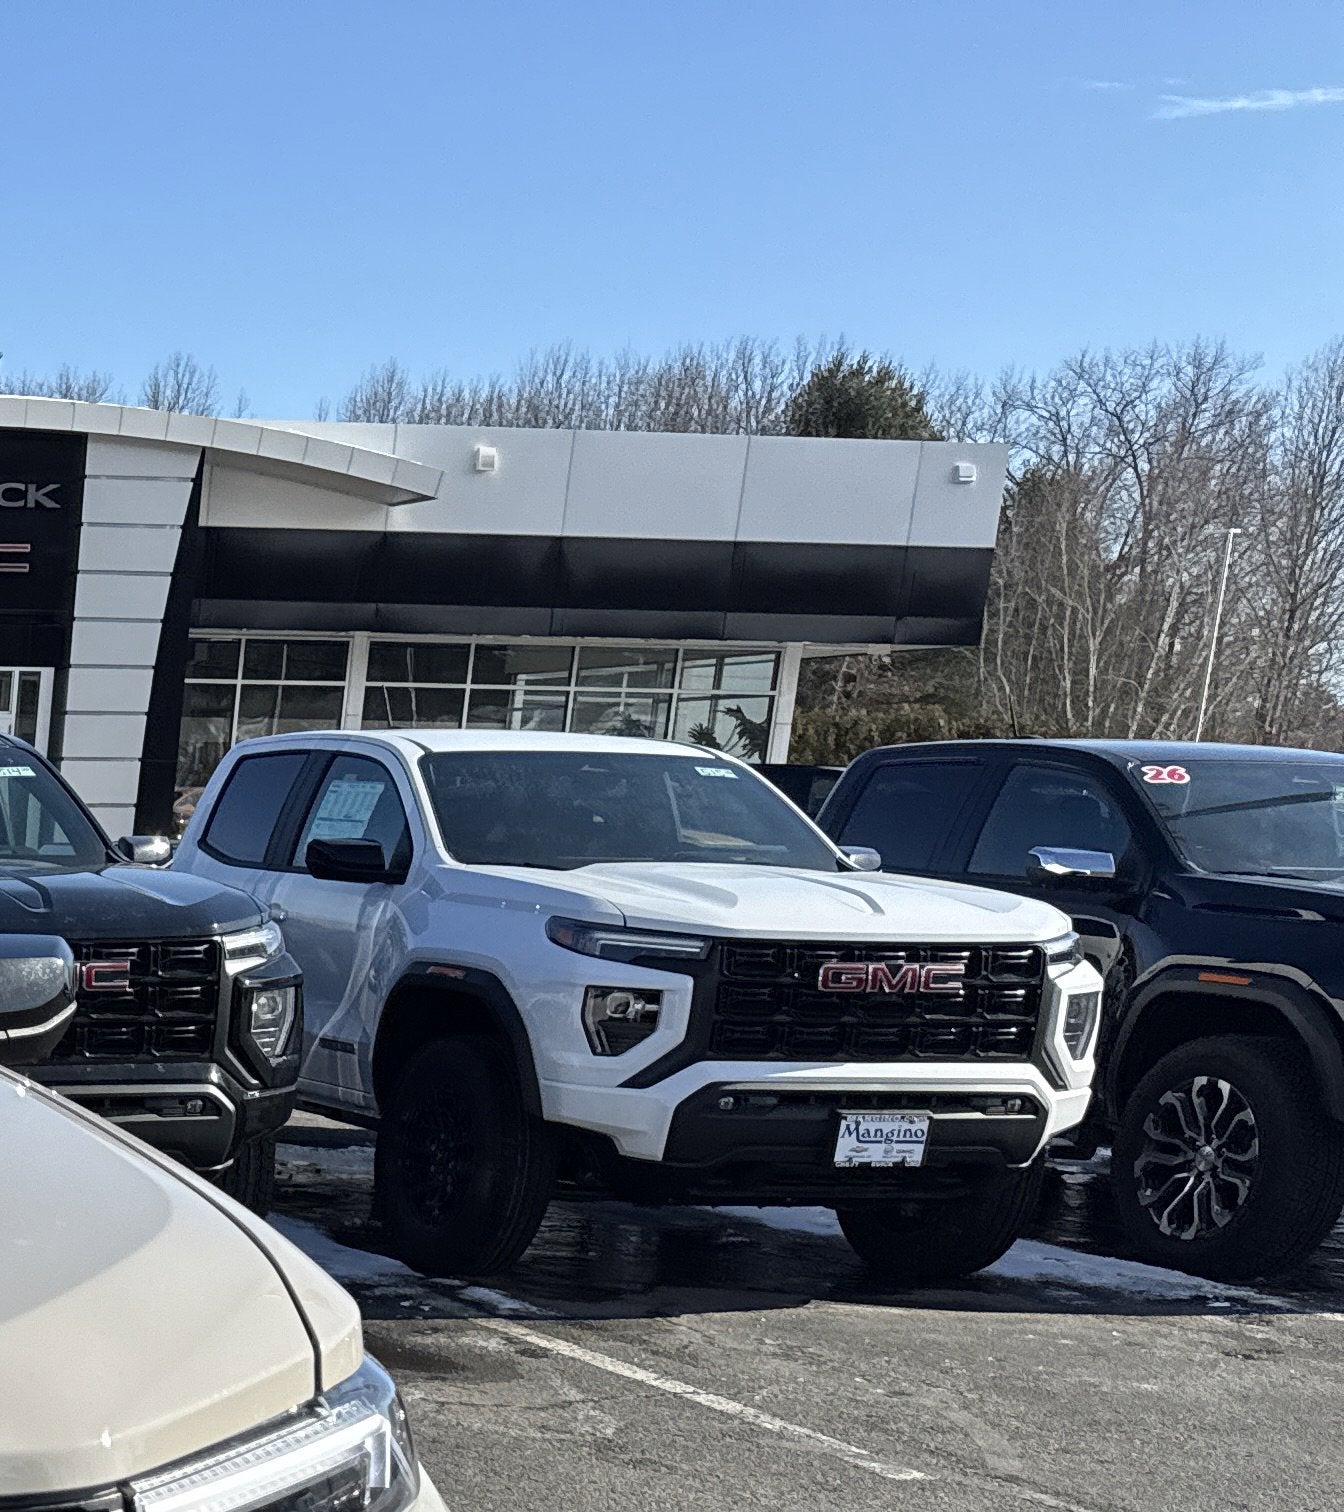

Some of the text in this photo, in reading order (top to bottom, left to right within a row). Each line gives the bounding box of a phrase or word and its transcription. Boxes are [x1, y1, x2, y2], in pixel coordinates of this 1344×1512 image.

[1141, 765, 1191, 784] 26
[818, 962, 965, 994] GMC
[840, 1120, 925, 1144] Mangino
